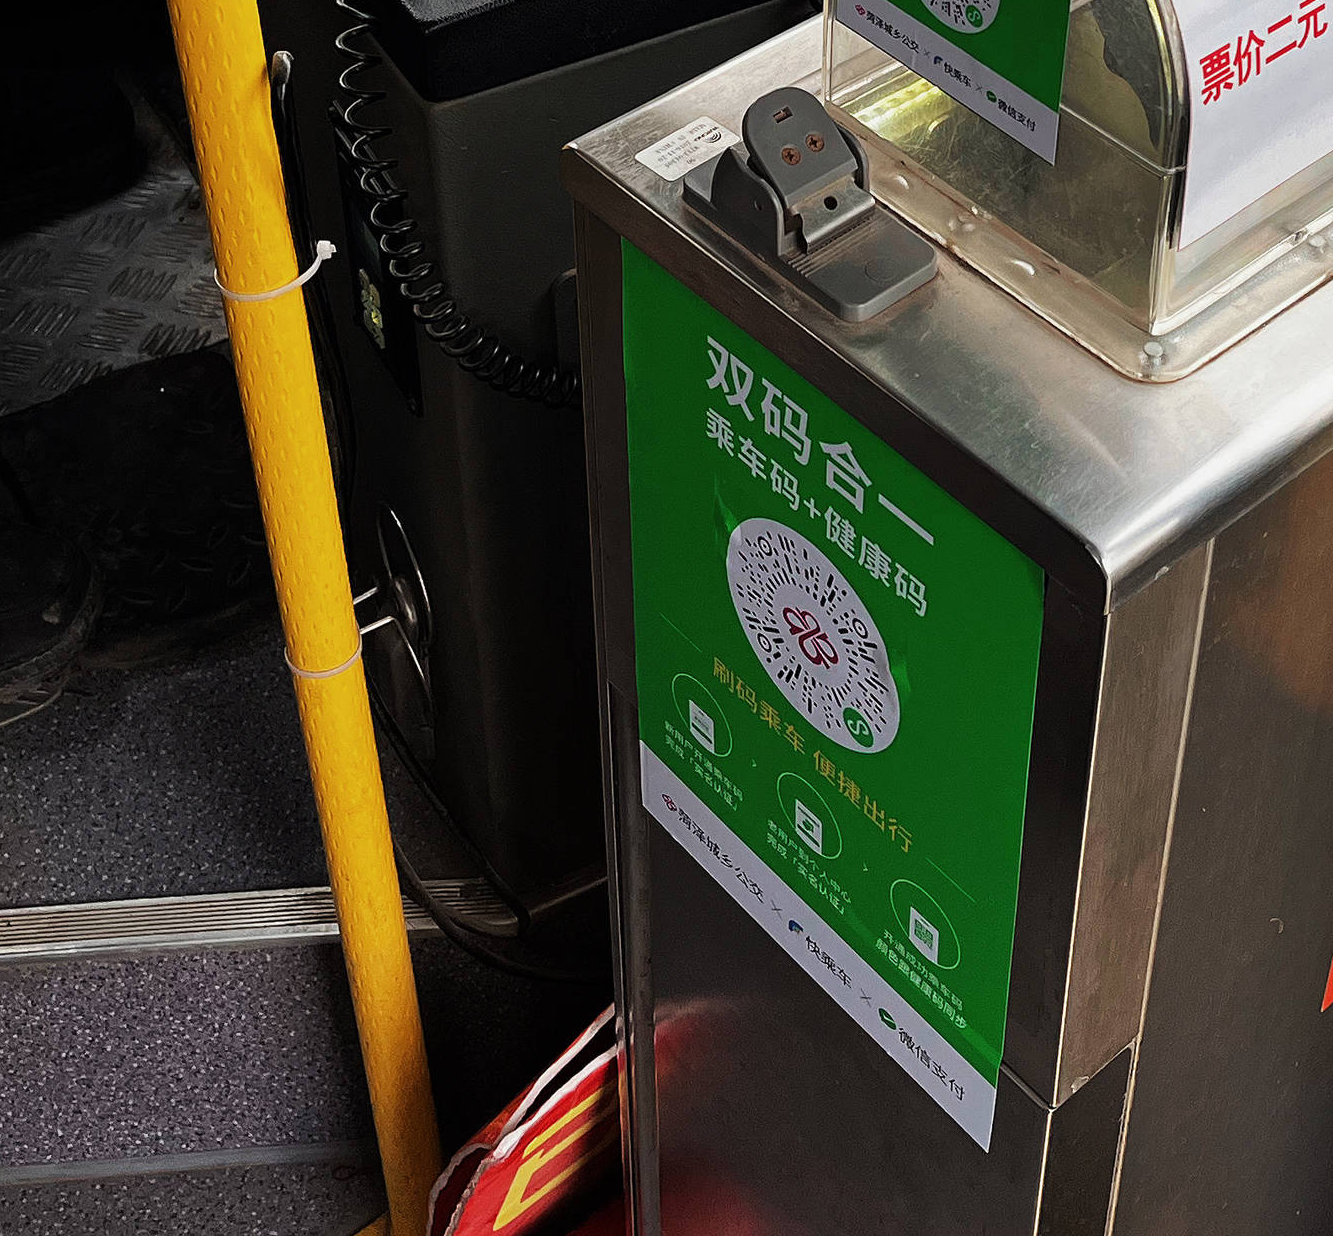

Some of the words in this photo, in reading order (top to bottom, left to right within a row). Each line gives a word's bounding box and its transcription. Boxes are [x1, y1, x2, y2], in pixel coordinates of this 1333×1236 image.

[866, 10, 920, 56] 菏泽城乡公交
[943, 61, 972, 90] 快乘车
[997, 98, 1037, 133] 微信支付
[706, 335, 934, 546] 双码合一
[706, 407, 927, 618] 乘车码+健康码
[713, 657, 806, 755] 刷码乘车
[812, 748, 914, 853] 便捷出行
[677, 807, 766, 905] 菏泽城乡公交
[805, 935, 852, 989] 快乘车
[897, 1028, 966, 1102] 微信支付
